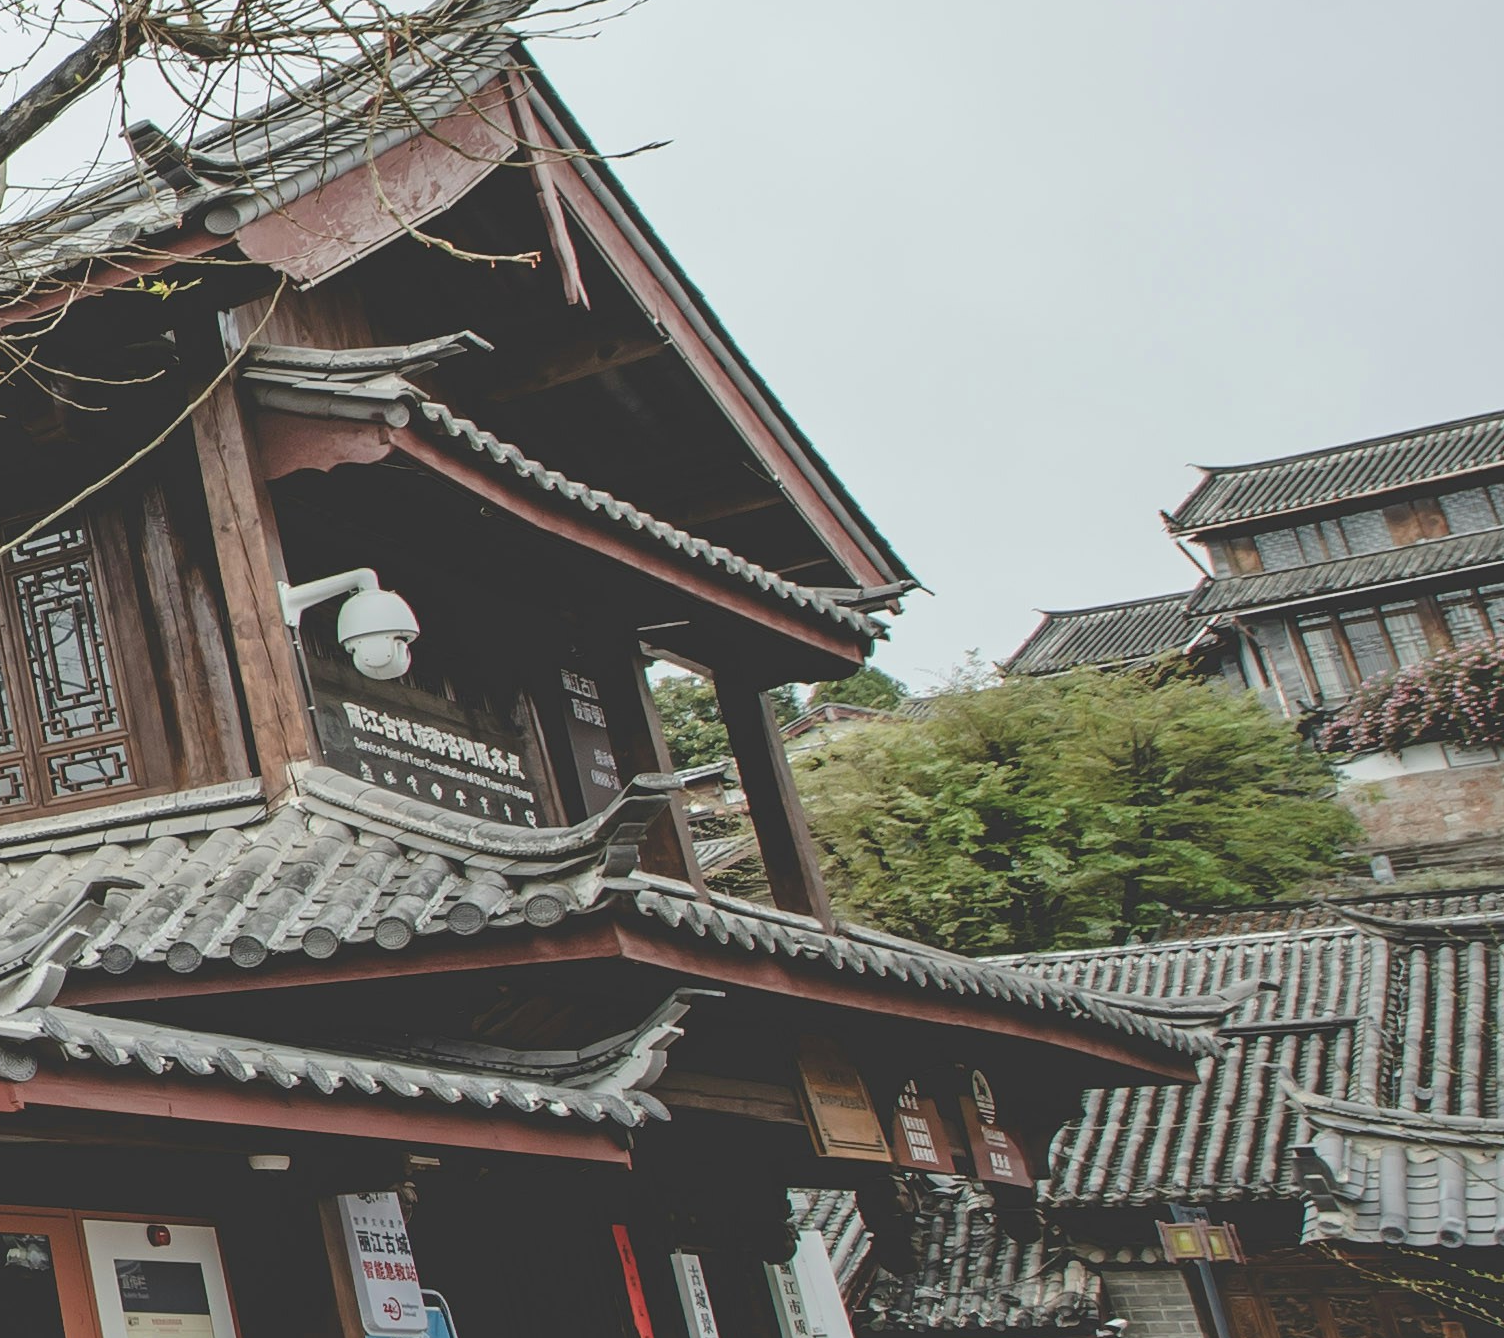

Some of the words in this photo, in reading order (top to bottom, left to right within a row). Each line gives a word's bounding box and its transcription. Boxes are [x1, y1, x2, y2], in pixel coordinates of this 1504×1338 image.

[355, 1230, 412, 1255] 丽江古城
[362, 1260, 419, 1281] 智能急救站
